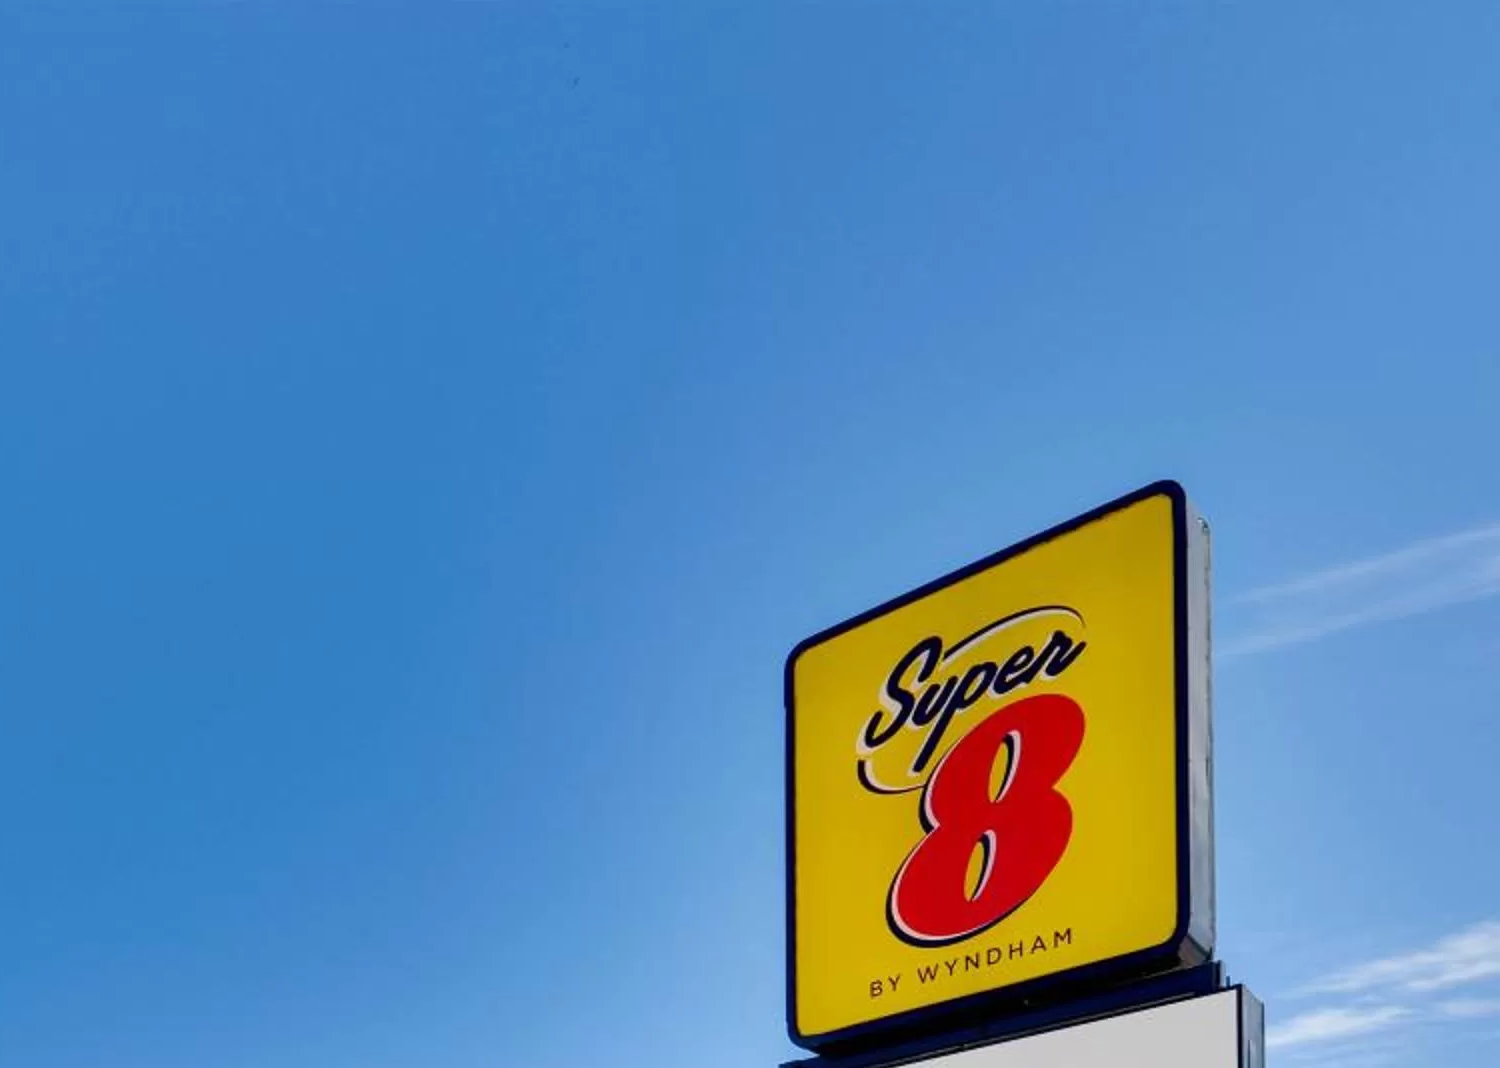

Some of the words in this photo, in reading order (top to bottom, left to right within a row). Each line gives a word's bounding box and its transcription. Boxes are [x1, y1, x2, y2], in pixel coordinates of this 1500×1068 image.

[858, 630, 1087, 775] Super
[886, 693, 1086, 947] 8
[869, 974, 901, 998] BY
[917, 927, 1073, 984] WYNDHAM
